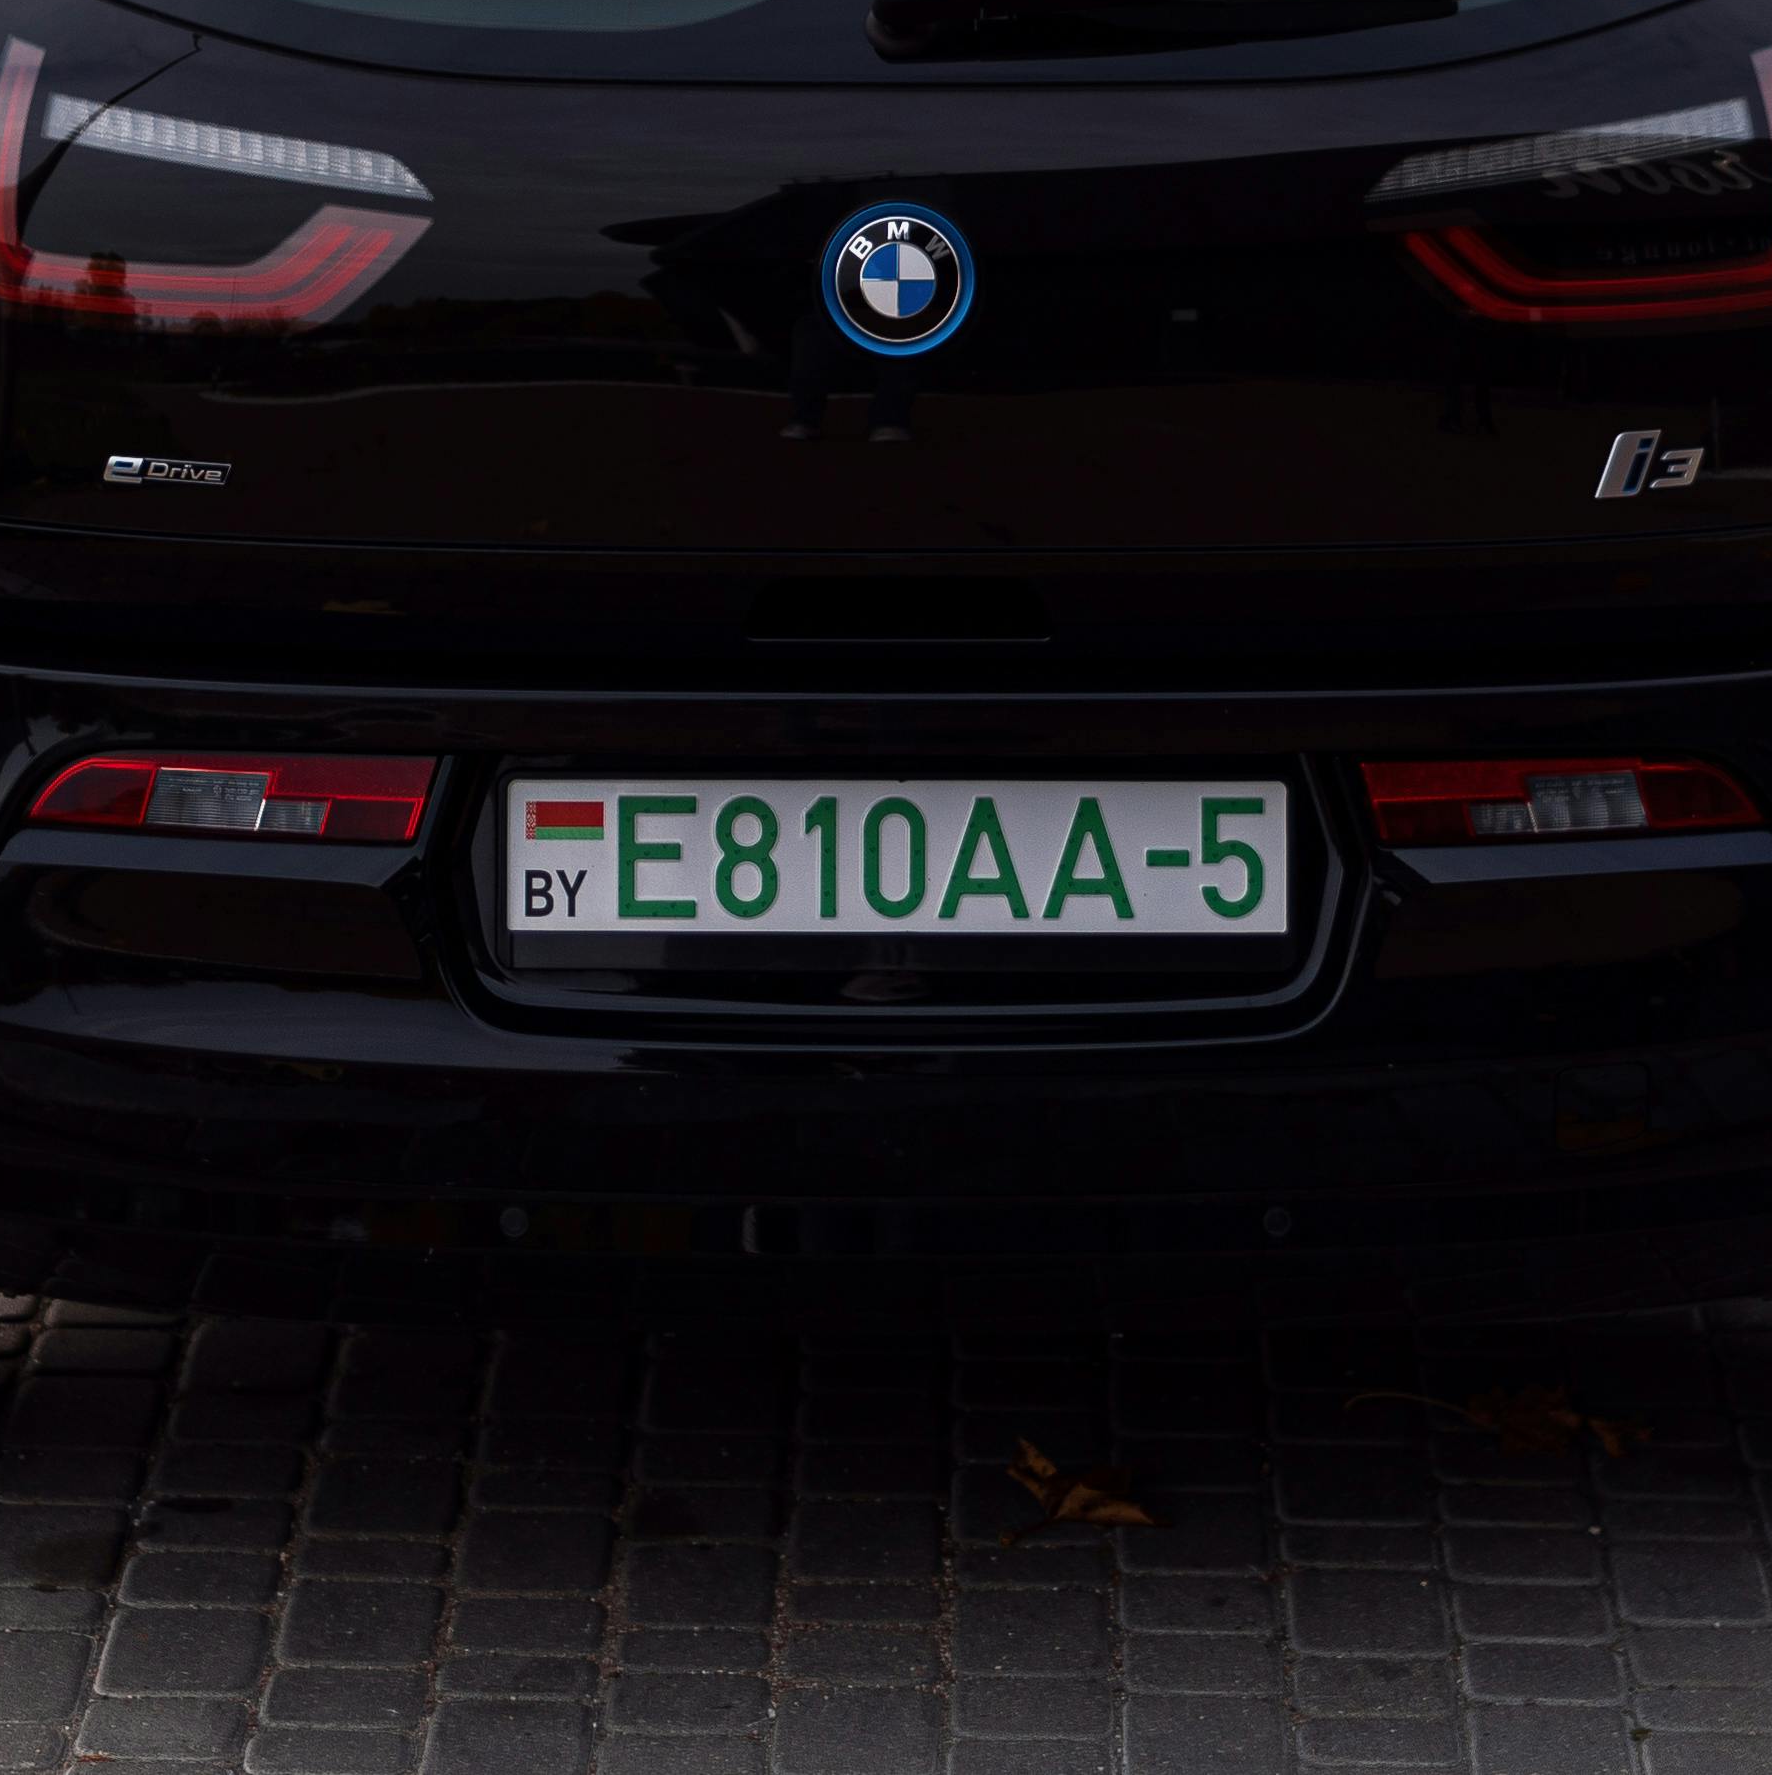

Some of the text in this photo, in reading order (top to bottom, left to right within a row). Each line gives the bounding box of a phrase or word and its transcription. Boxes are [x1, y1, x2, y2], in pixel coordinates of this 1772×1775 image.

[849, 221, 950, 260] BMW
[1595, 429, 1704, 498] i3
[617, 794, 1265, 919] E810AA-5
[524, 869, 588, 918] BY
